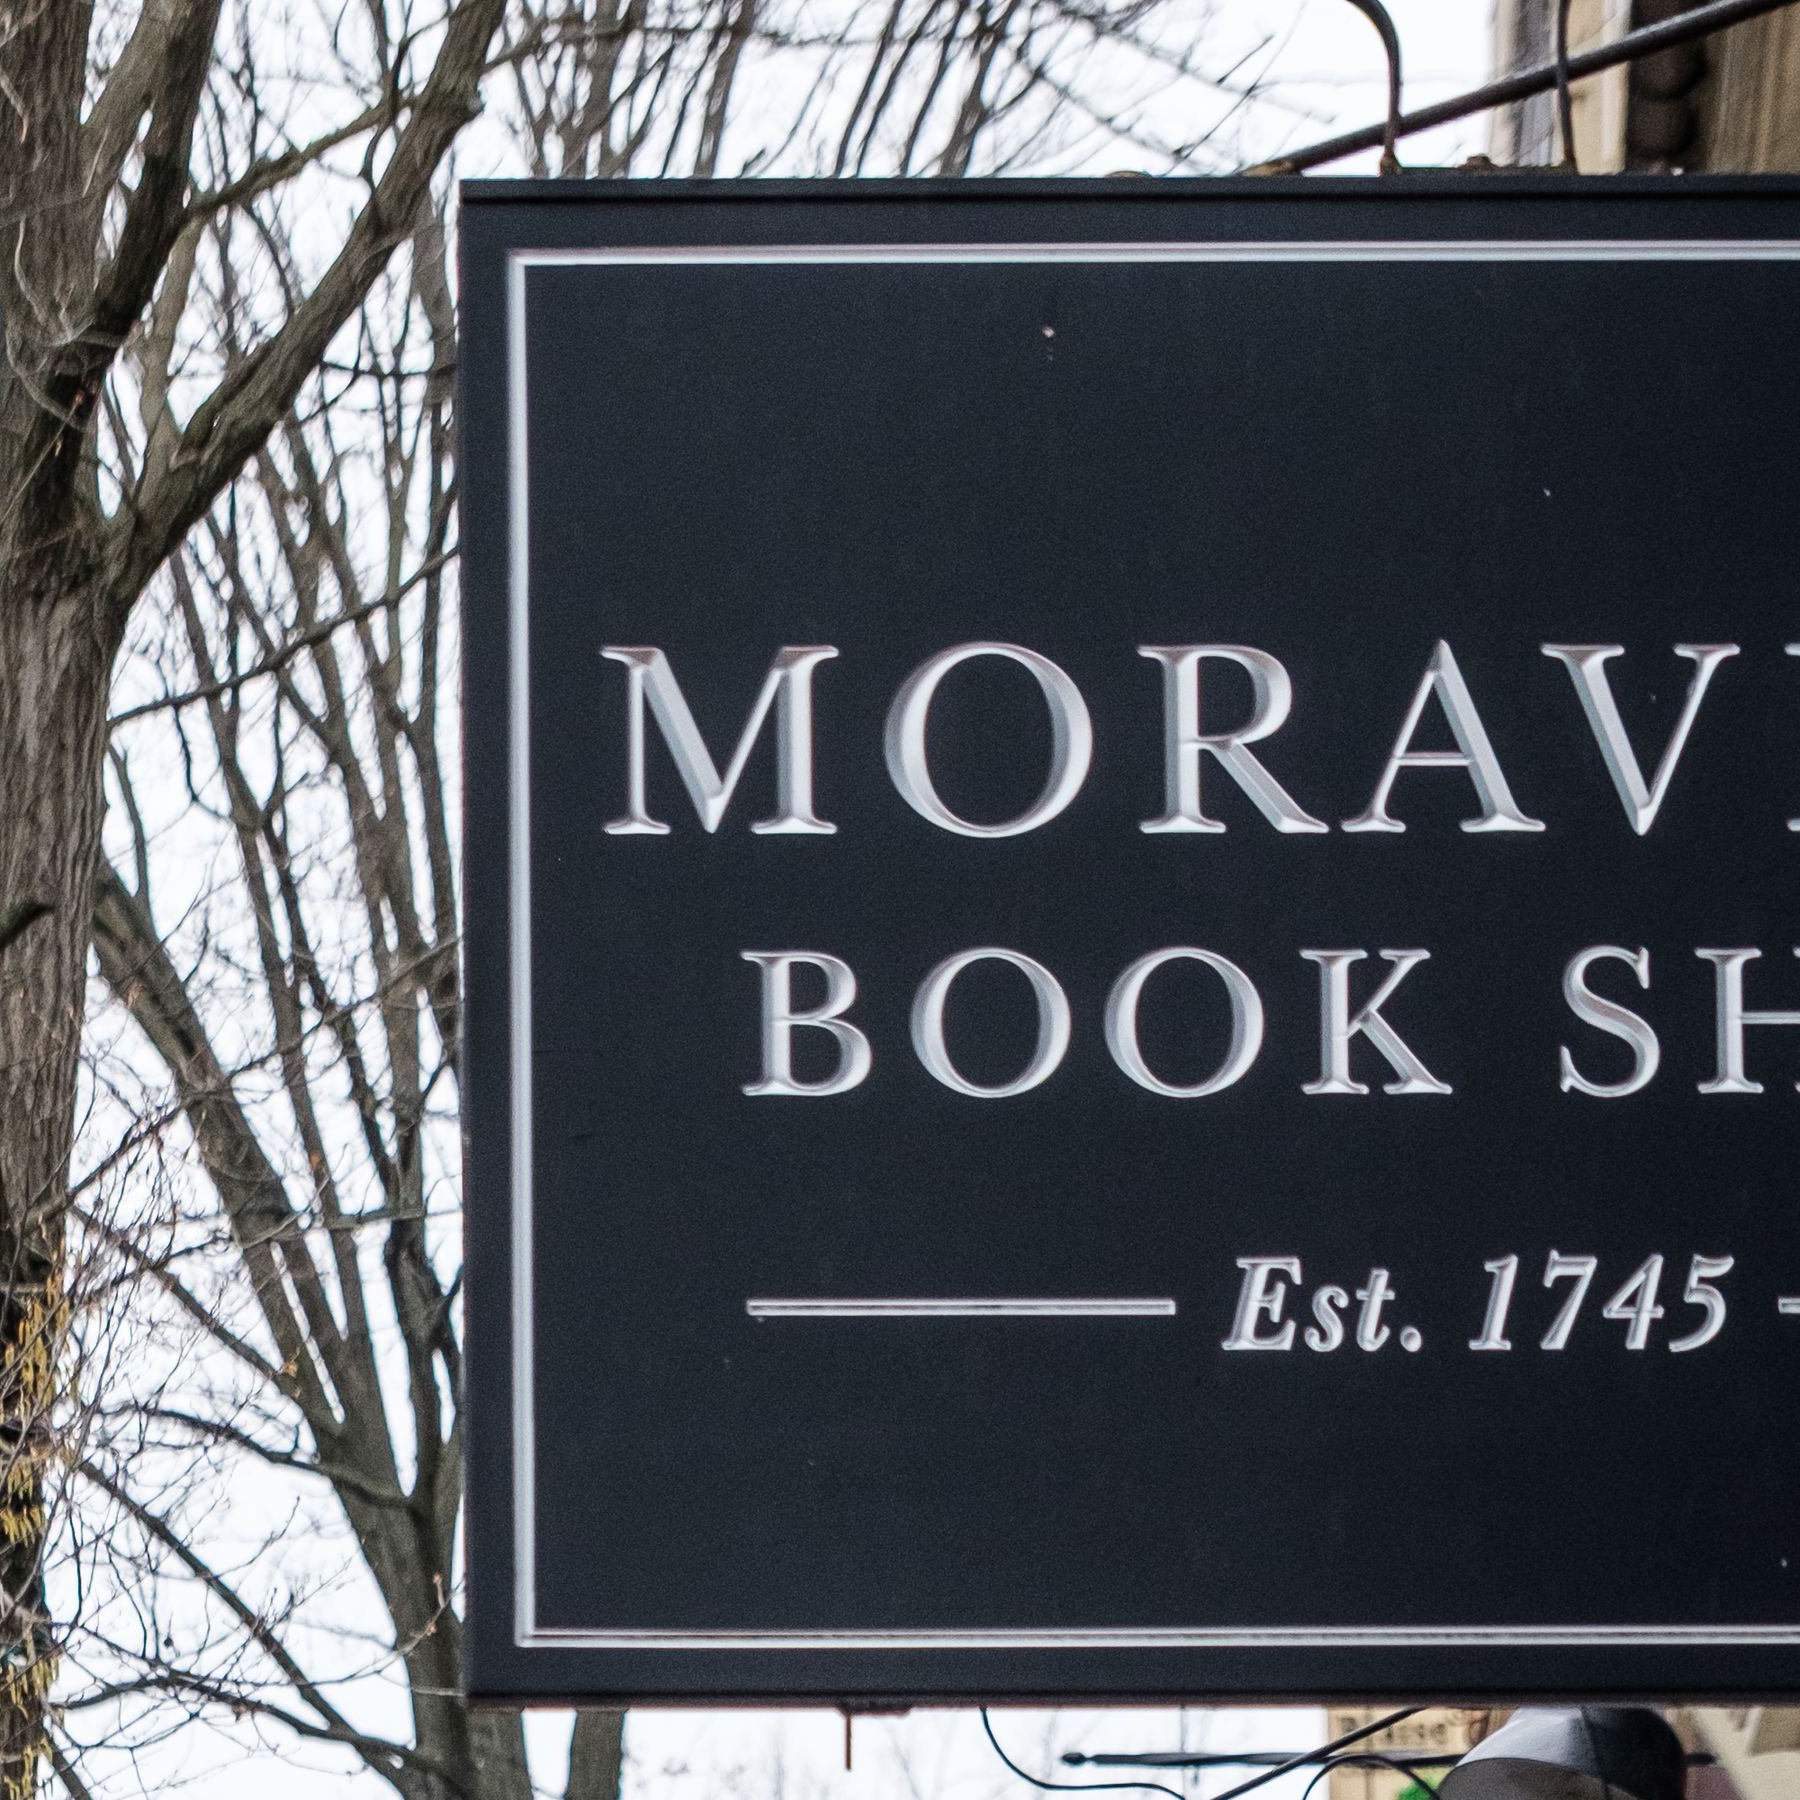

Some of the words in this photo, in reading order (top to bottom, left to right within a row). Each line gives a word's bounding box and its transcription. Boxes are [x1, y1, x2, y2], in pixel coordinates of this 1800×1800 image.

[739, 945, 1455, 1099] BOOK
[1220, 1255, 1424, 1354] Est.
[1467, 1248, 1736, 1354] 1745
